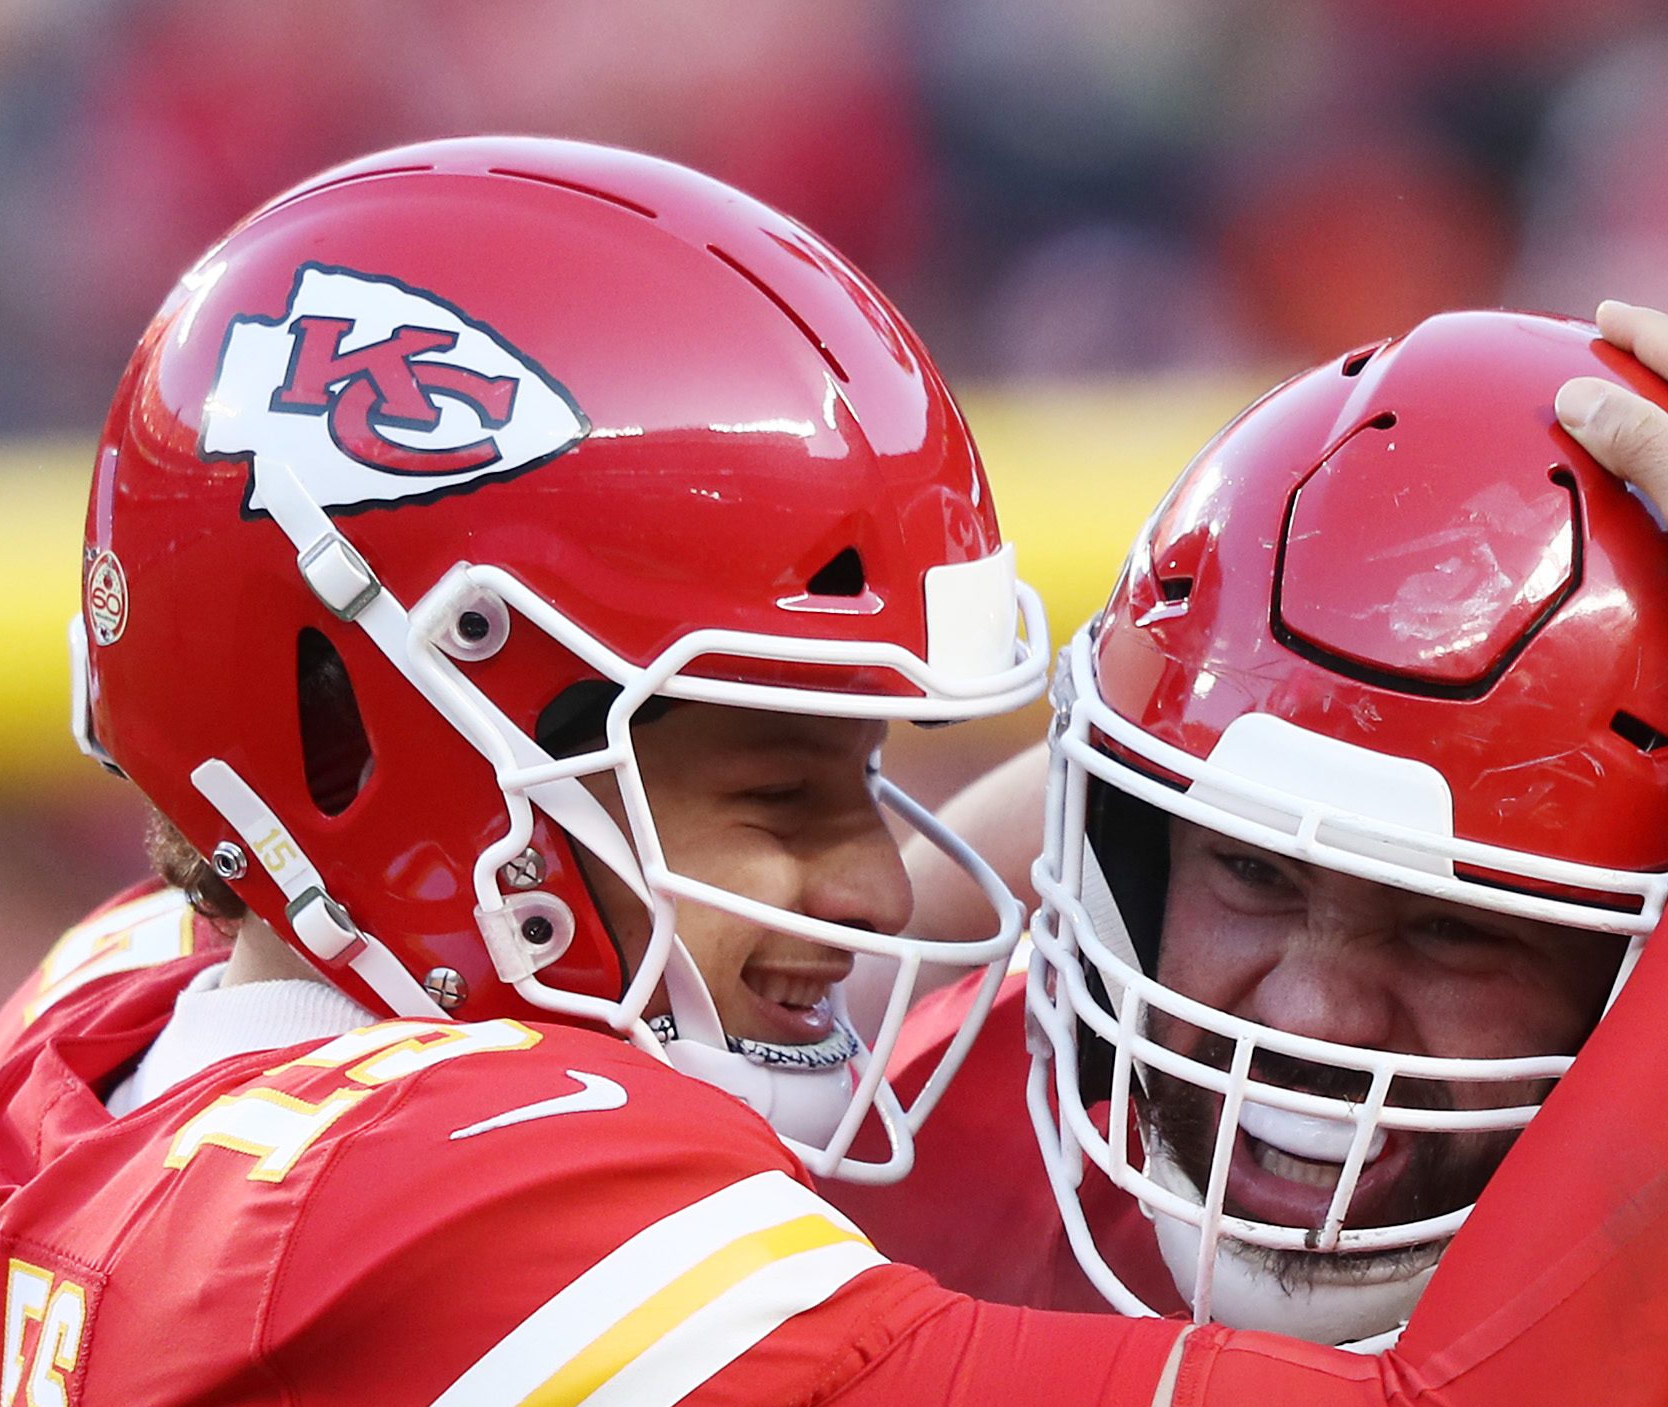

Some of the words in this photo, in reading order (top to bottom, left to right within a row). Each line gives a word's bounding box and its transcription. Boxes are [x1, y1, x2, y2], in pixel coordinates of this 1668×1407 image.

[269, 315, 520, 476] KC
[92, 587, 121, 616] 60
[253, 828, 297, 872] 15
[163, 1018, 544, 1183] 15
